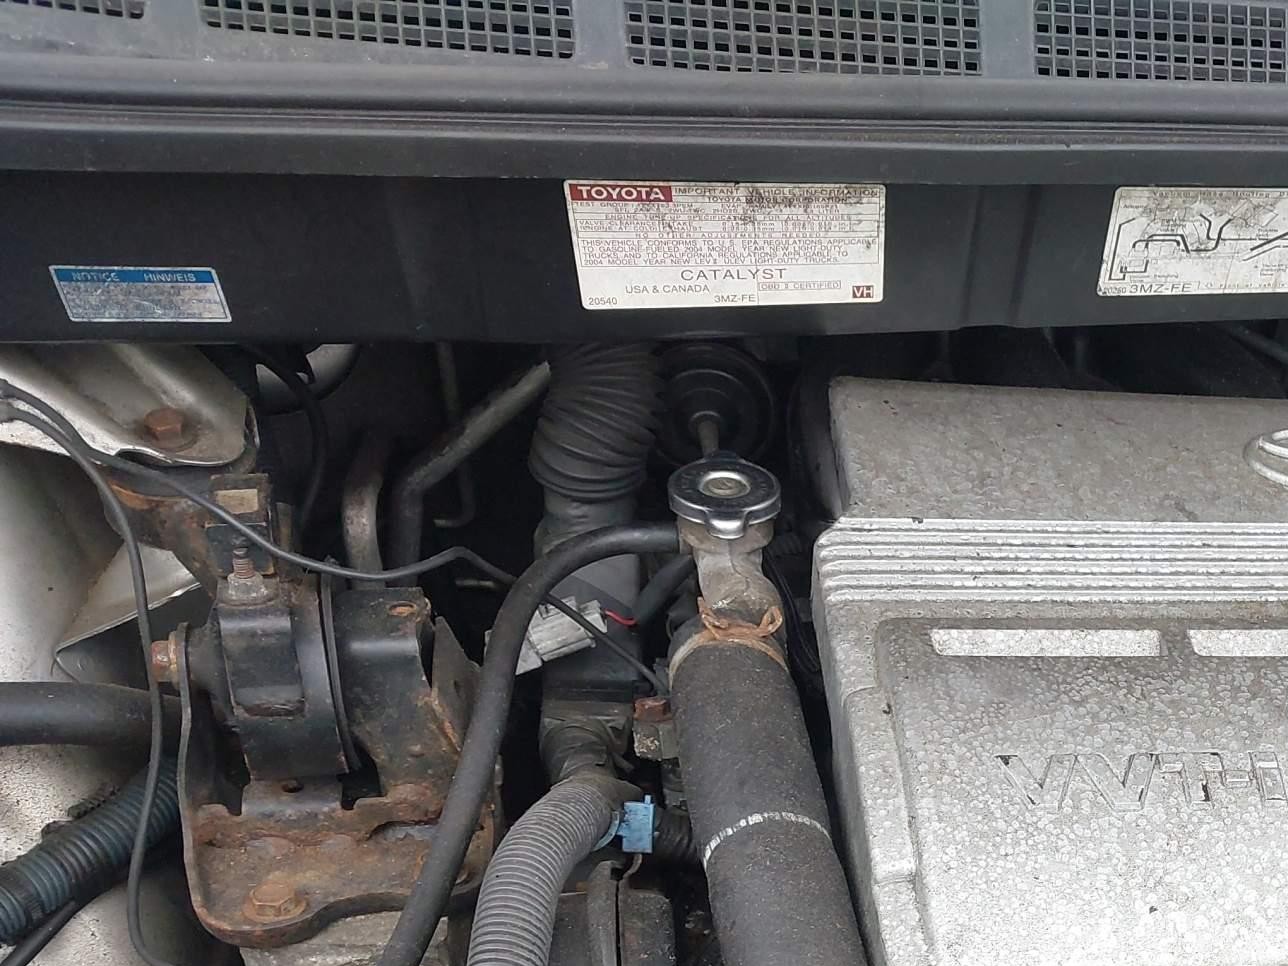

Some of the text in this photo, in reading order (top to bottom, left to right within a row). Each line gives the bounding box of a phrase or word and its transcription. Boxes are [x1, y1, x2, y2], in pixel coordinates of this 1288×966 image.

[577, 186, 665, 200] TOYOTA
[675, 187, 739, 195] IMPORTANT
[803, 189, 878, 197] INFORMATION
[71, 272, 196, 282] NOTICE HINWEIS
[681, 268, 787, 281] CATALYST
[625, 284, 710, 293] USA & CANADA
[854, 286, 873, 297] VH
[1129, 283, 1194, 294] 3MZ-FE
[588, 297, 618, 306] 20540
[714, 294, 756, 304] 3MZ-FE
